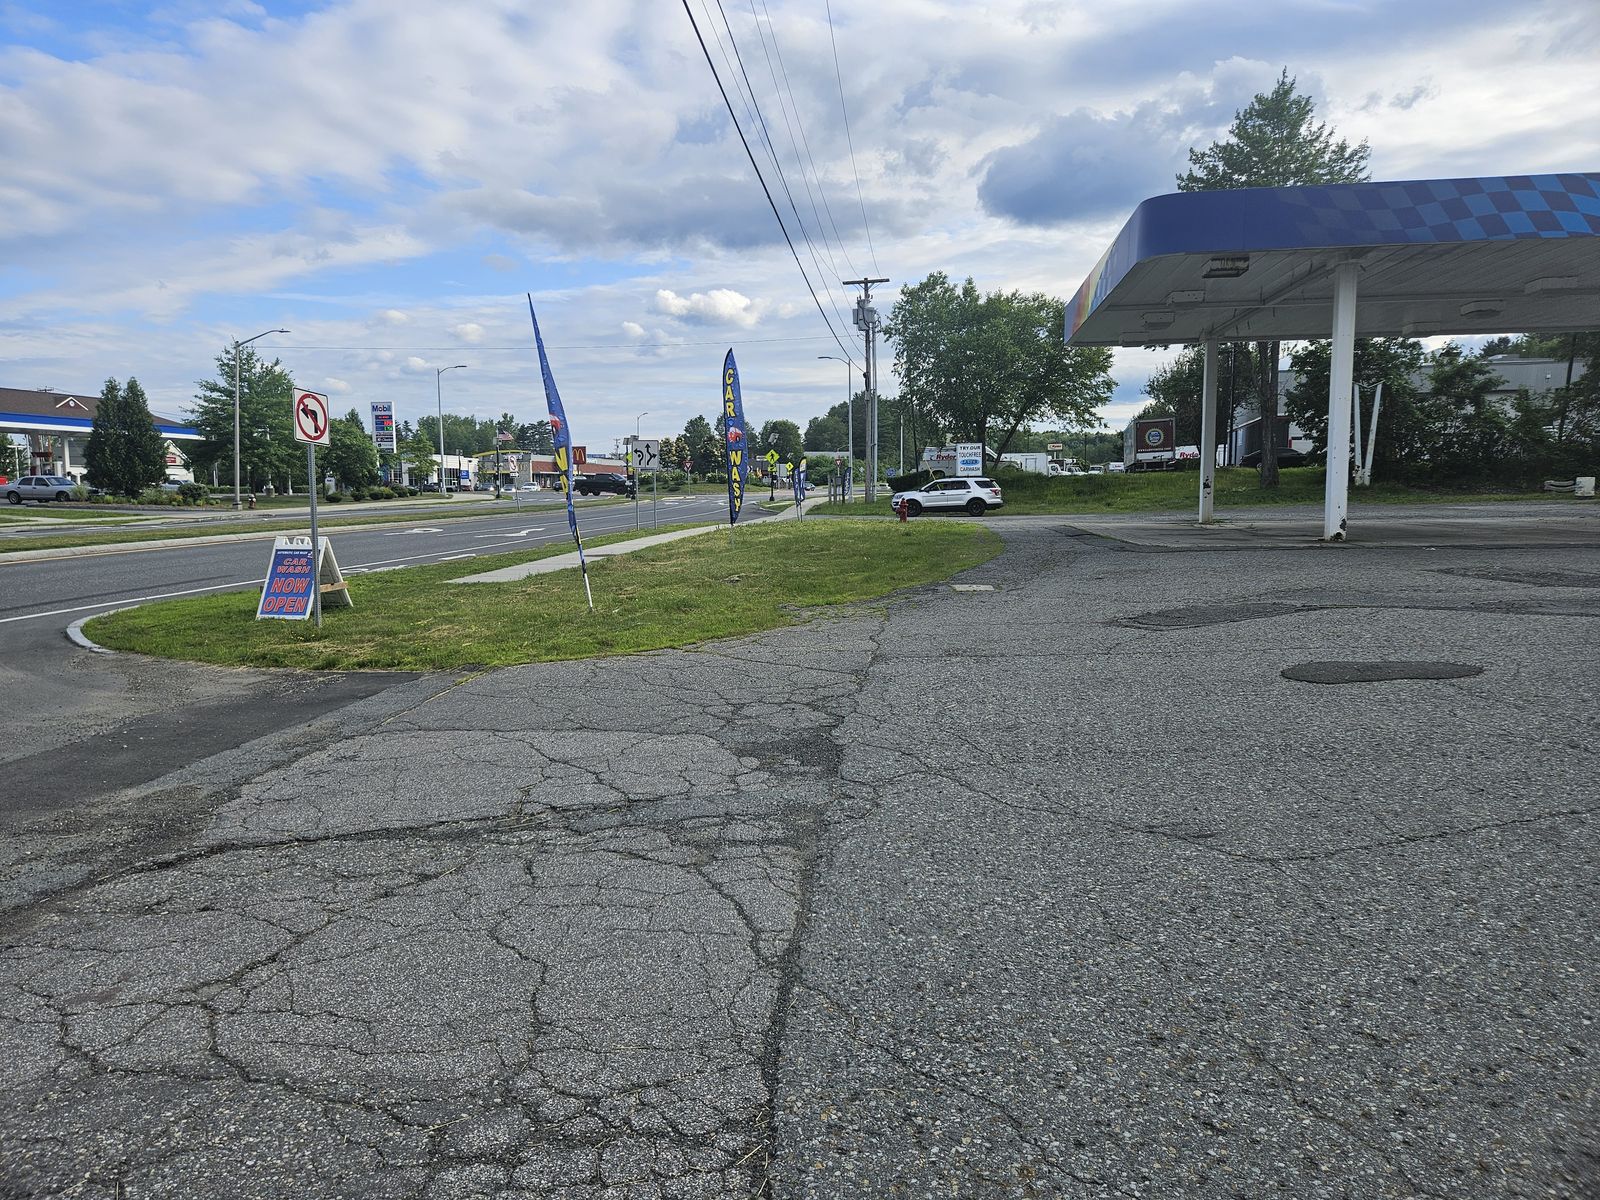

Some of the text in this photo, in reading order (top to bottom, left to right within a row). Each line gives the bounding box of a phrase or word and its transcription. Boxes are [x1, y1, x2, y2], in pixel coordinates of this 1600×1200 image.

[725, 368, 736, 417] CAR
[276, 566, 311, 574] WASH
[270, 578, 310, 594] NOW
[263, 596, 308, 612] OPEN
